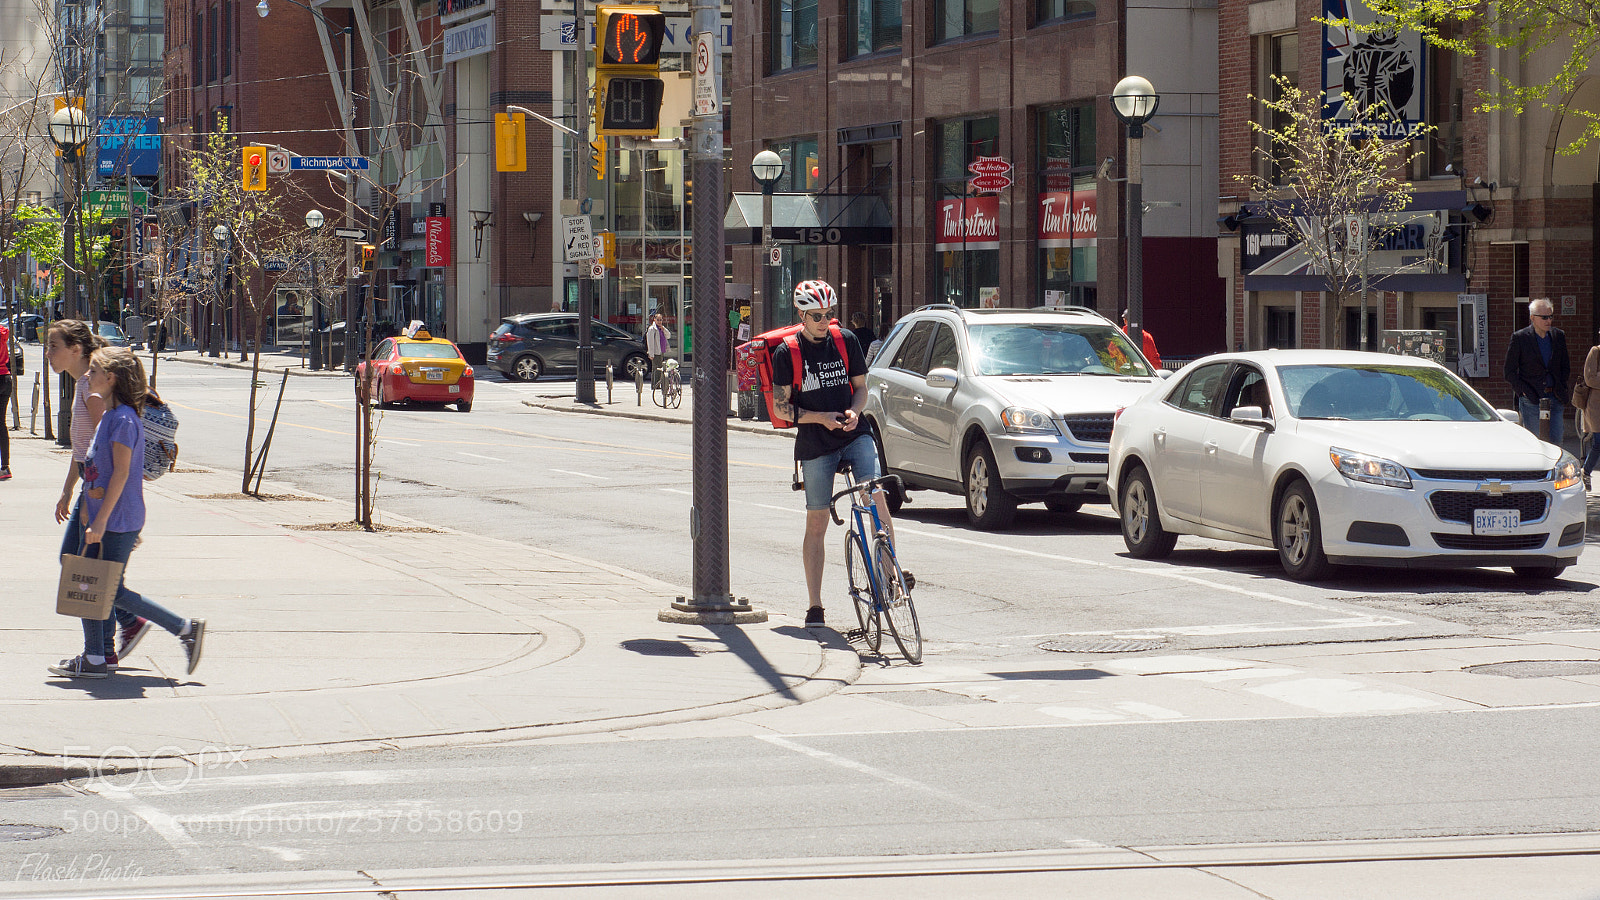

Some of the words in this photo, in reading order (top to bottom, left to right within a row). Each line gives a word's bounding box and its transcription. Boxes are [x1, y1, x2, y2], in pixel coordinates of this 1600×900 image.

[100, 119, 147, 134] EYES
[100, 136, 124, 149] UP
[300, 158, 343, 167] Richmond
[351, 158, 359, 167] W
[975, 163, 986, 171] Tim
[986, 163, 1008, 171] Hortons
[943, 204, 958, 238] Tim
[1042, 197, 1061, 233] Tim
[429, 220, 442, 264] Michaels
[795, 228, 842, 244] 150
[1245, 234, 1260, 256] 160
[1260, 234, 1271, 247] JOHN
[1271, 234, 1287, 247] STREET
[819, 367, 847, 379] Sound
[1476, 515, 1497, 528] BXXF
[1502, 515, 1519, 528] 313
[71, 574, 99, 584] BRANDY
[67, 591, 97, 602] MELVILLE
